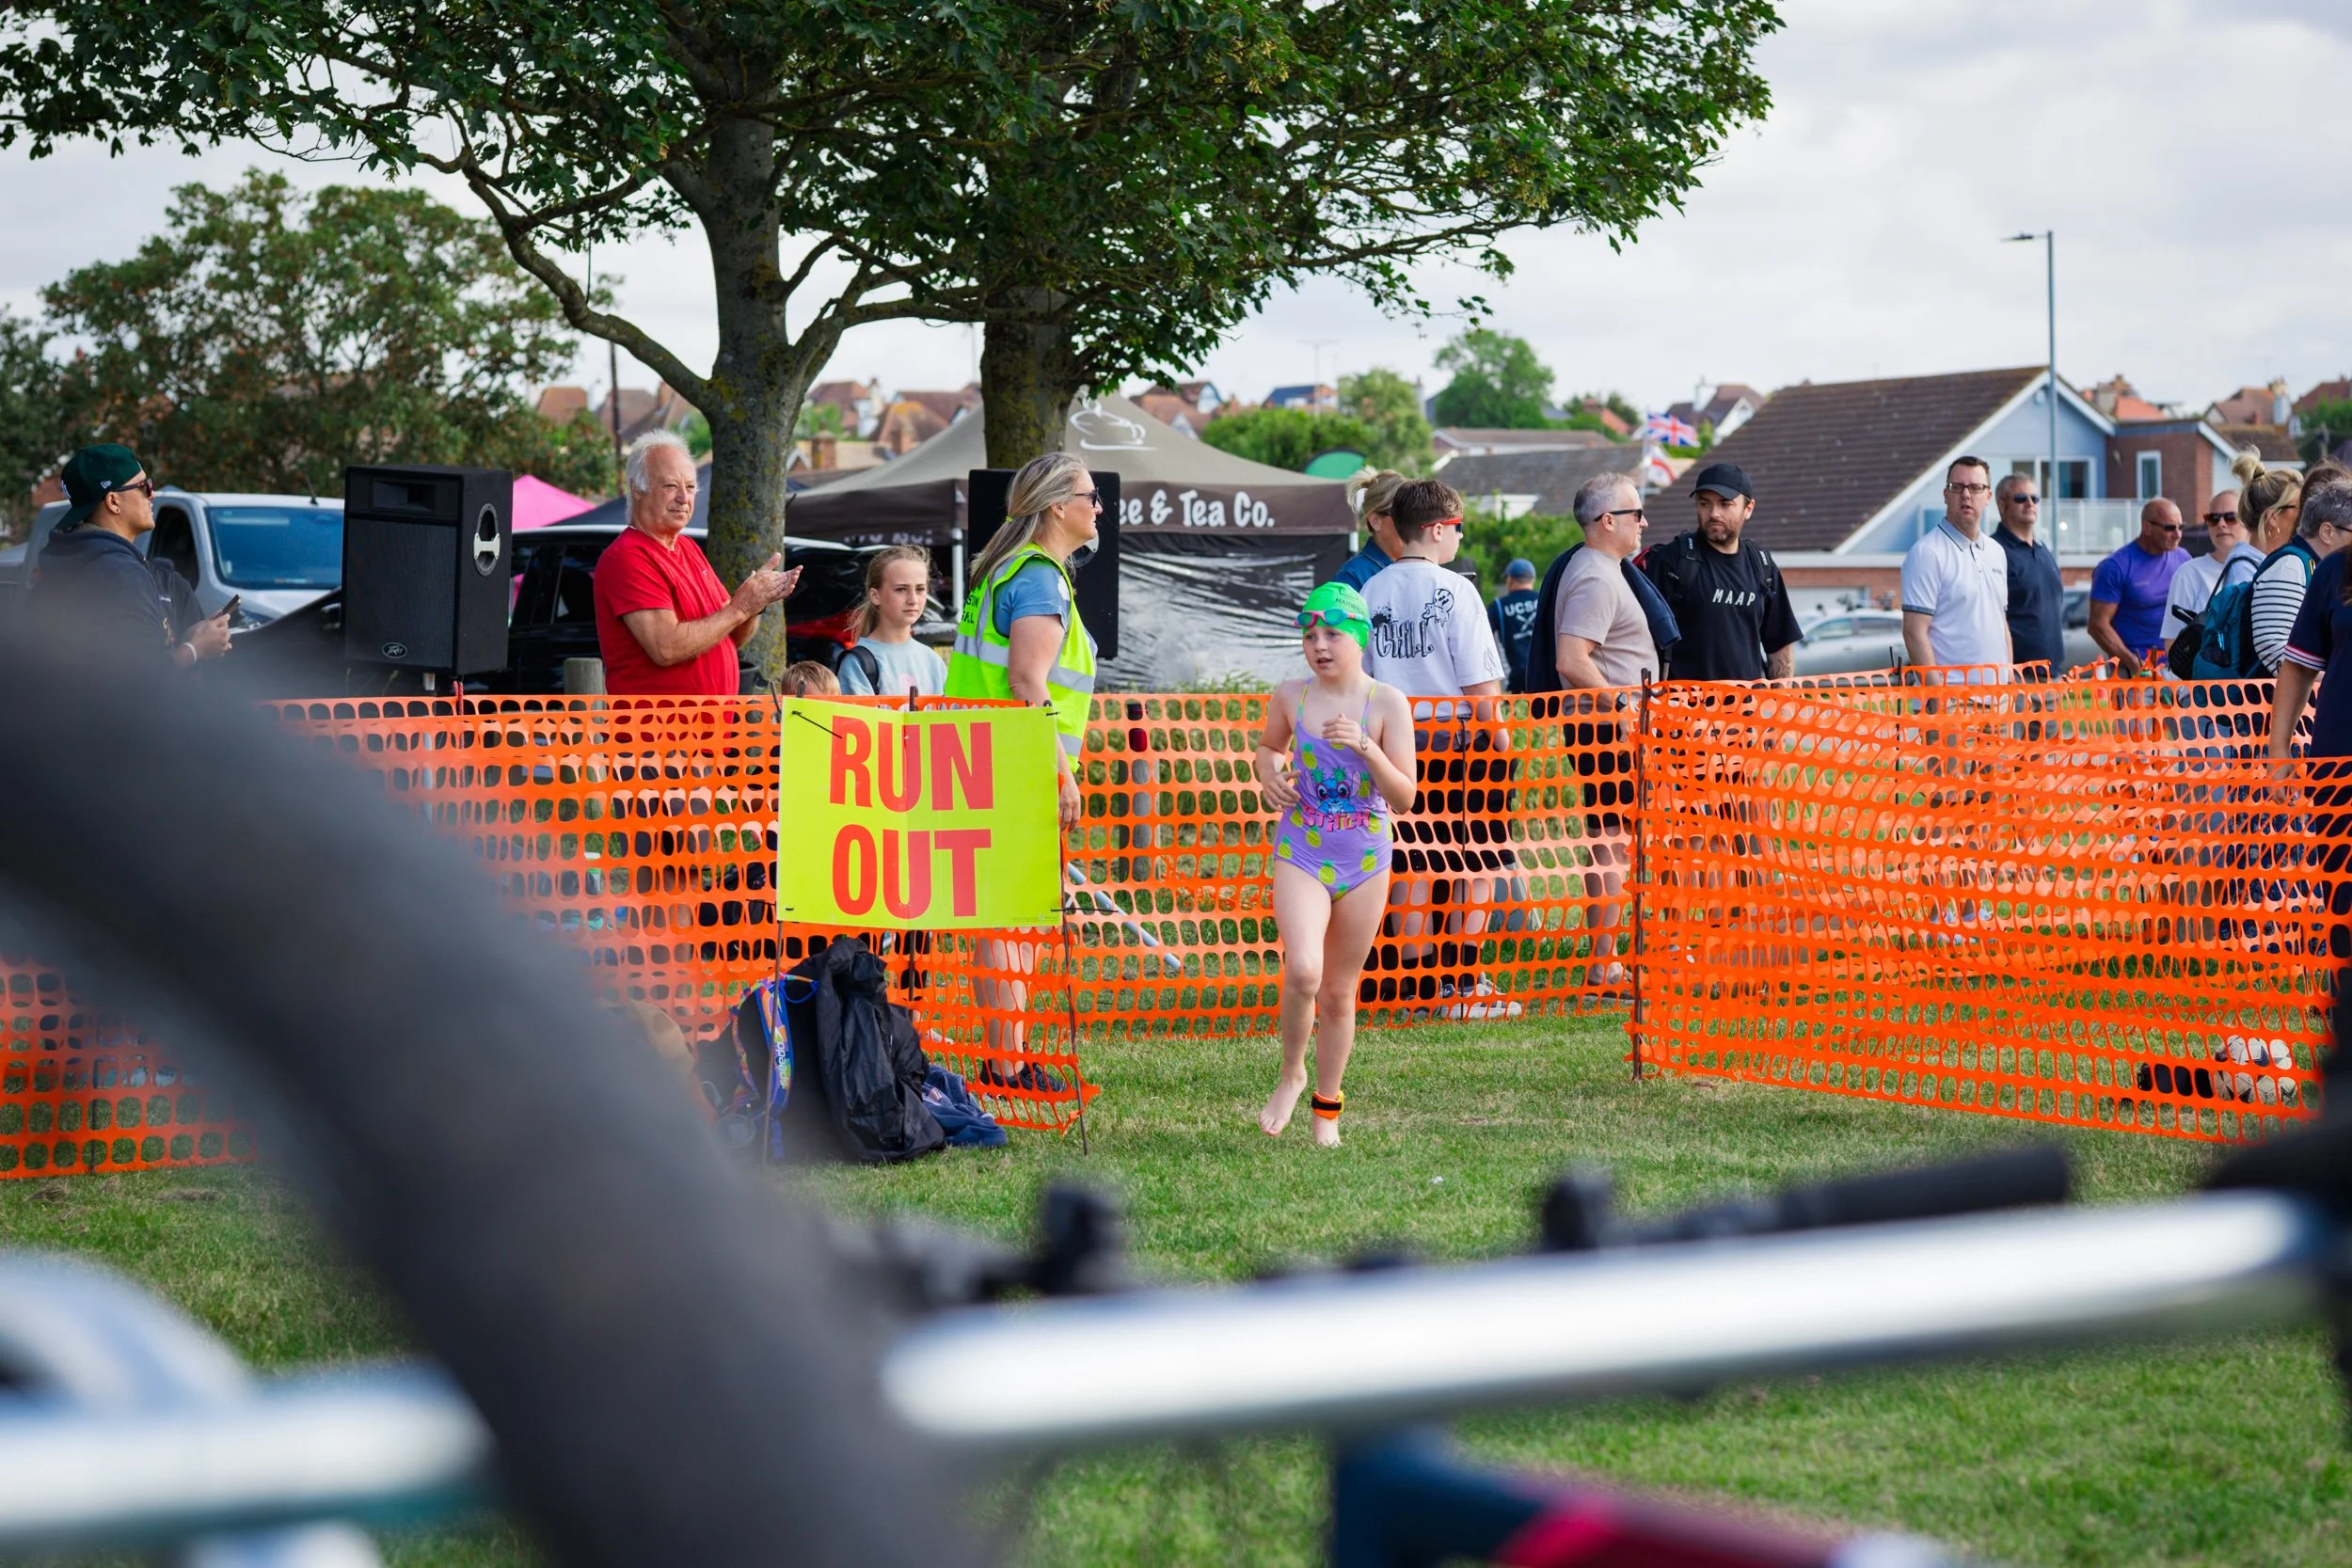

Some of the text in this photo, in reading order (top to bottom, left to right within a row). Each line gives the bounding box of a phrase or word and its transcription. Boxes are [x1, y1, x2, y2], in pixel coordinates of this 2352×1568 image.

[1150, 489, 1173, 526] &
[1178, 489, 1227, 528] Tea
[1233, 490, 1276, 528] Co.
[1712, 588, 1756, 607] MAAP
[829, 714, 994, 814] RUN
[1302, 804, 1372, 833] STITCH
[832, 823, 993, 920] OUT
[775, 1041, 788, 1090] speedo
